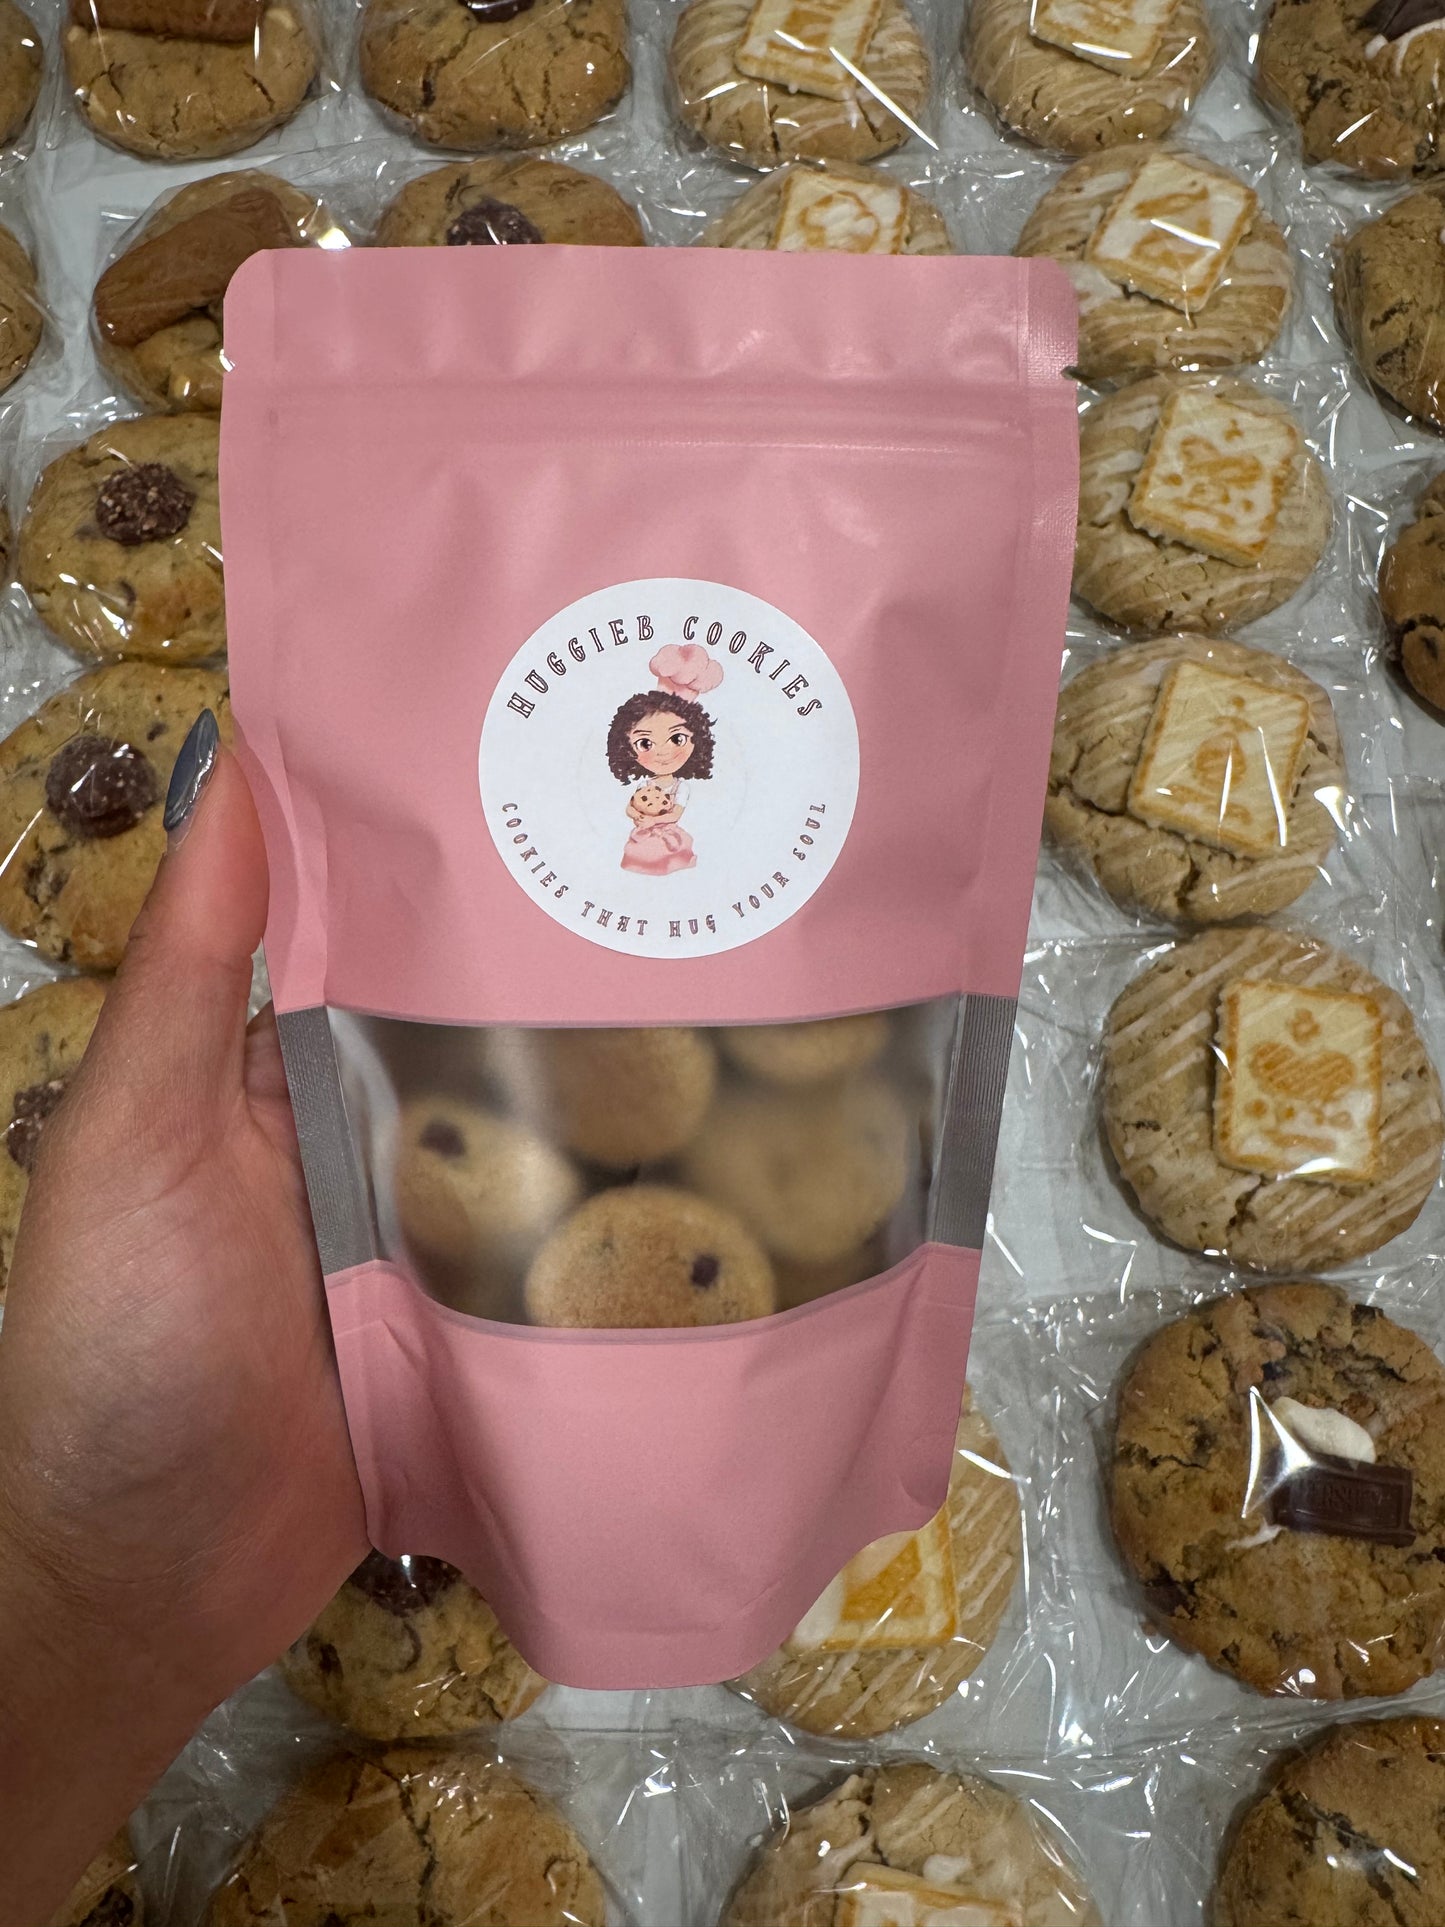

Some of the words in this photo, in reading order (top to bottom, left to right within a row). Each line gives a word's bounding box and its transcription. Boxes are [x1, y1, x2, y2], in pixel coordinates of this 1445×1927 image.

[506, 615, 655, 719] HUGGIEB
[683, 615, 823, 717] COOKIES
[501, 802, 569, 898] COOKIES
[580, 900, 648, 936] THAT
[668, 914, 717, 938] HUG
[731, 871, 790, 918] YOUR
[792, 803, 826, 861] SOUL
